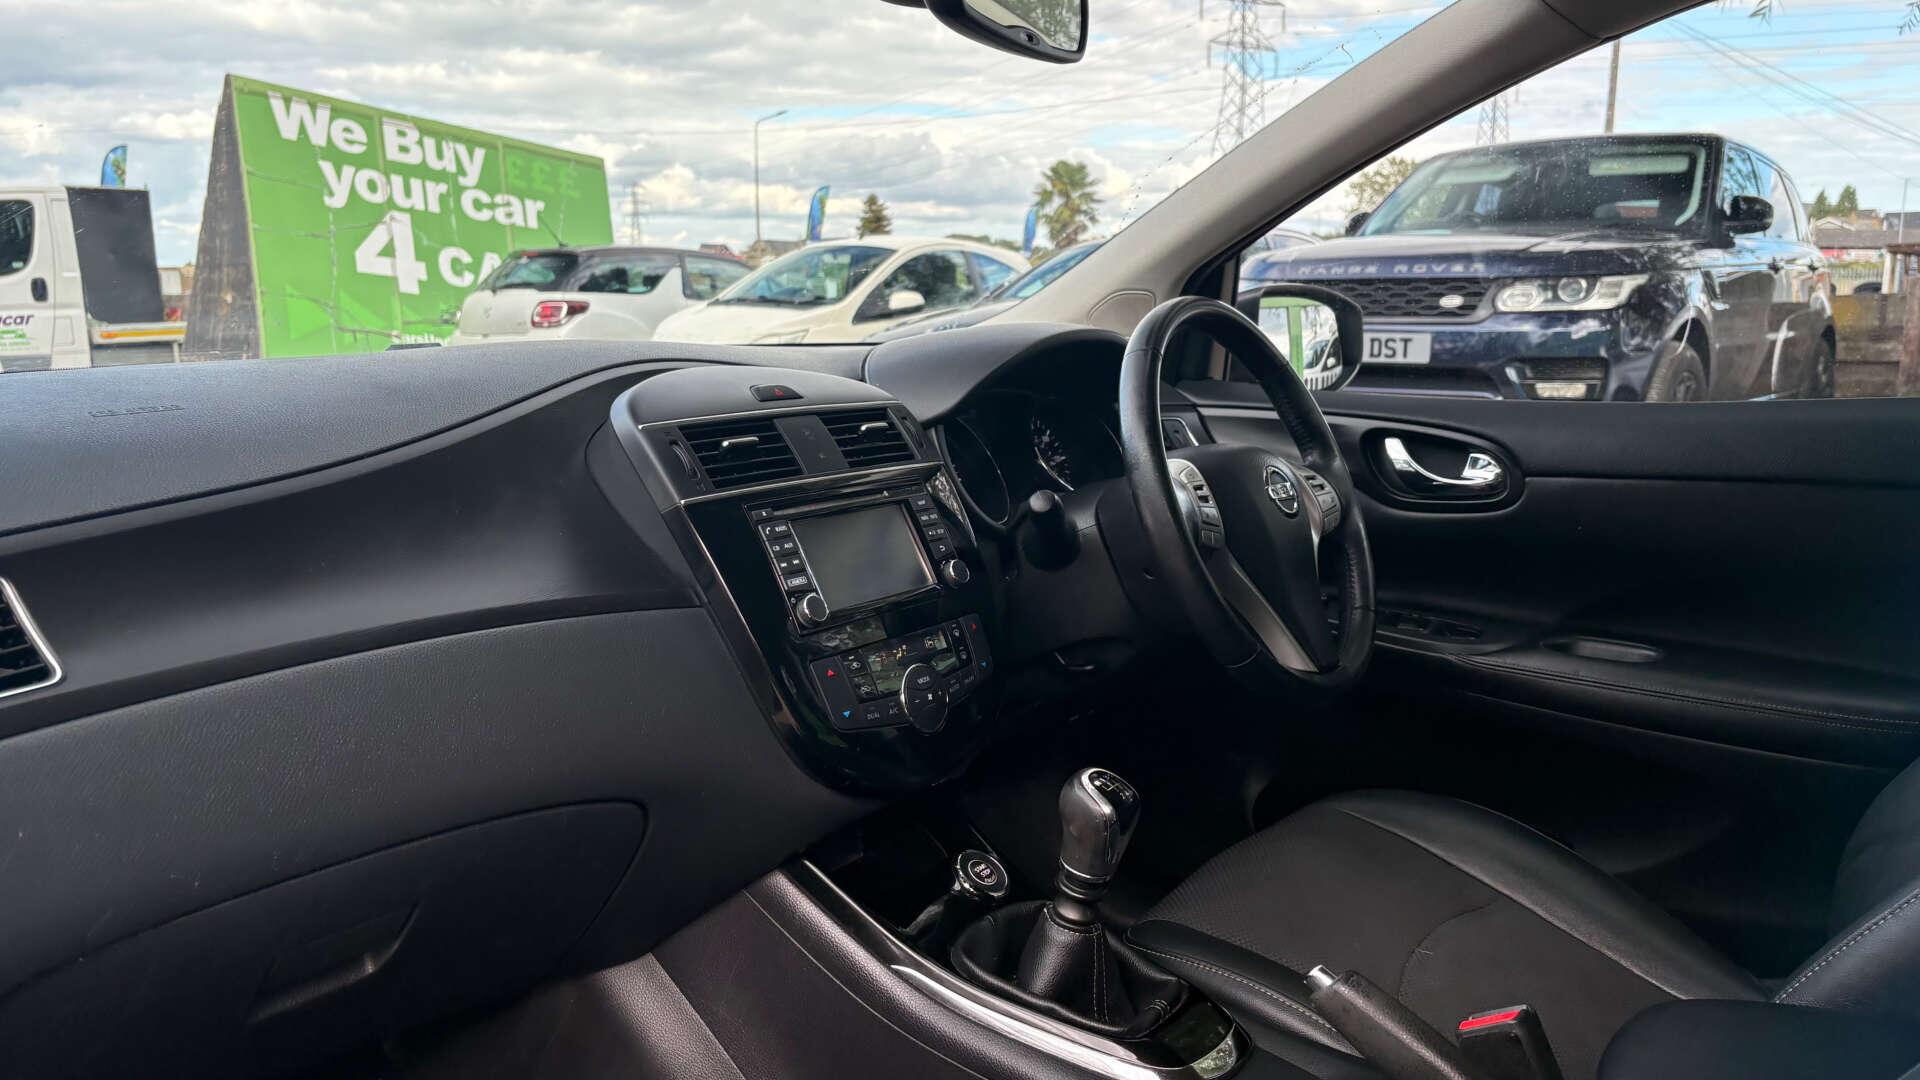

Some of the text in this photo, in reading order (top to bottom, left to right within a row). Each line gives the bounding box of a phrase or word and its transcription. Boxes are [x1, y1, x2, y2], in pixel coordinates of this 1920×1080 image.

[267, 91, 486, 186] We Buy
[317, 159, 545, 229] your car
[354, 209, 428, 295] 4
[1393, 262, 1487, 275] ROVER
[0, 313, 34, 326] car
[1369, 338, 1413, 359] DST
